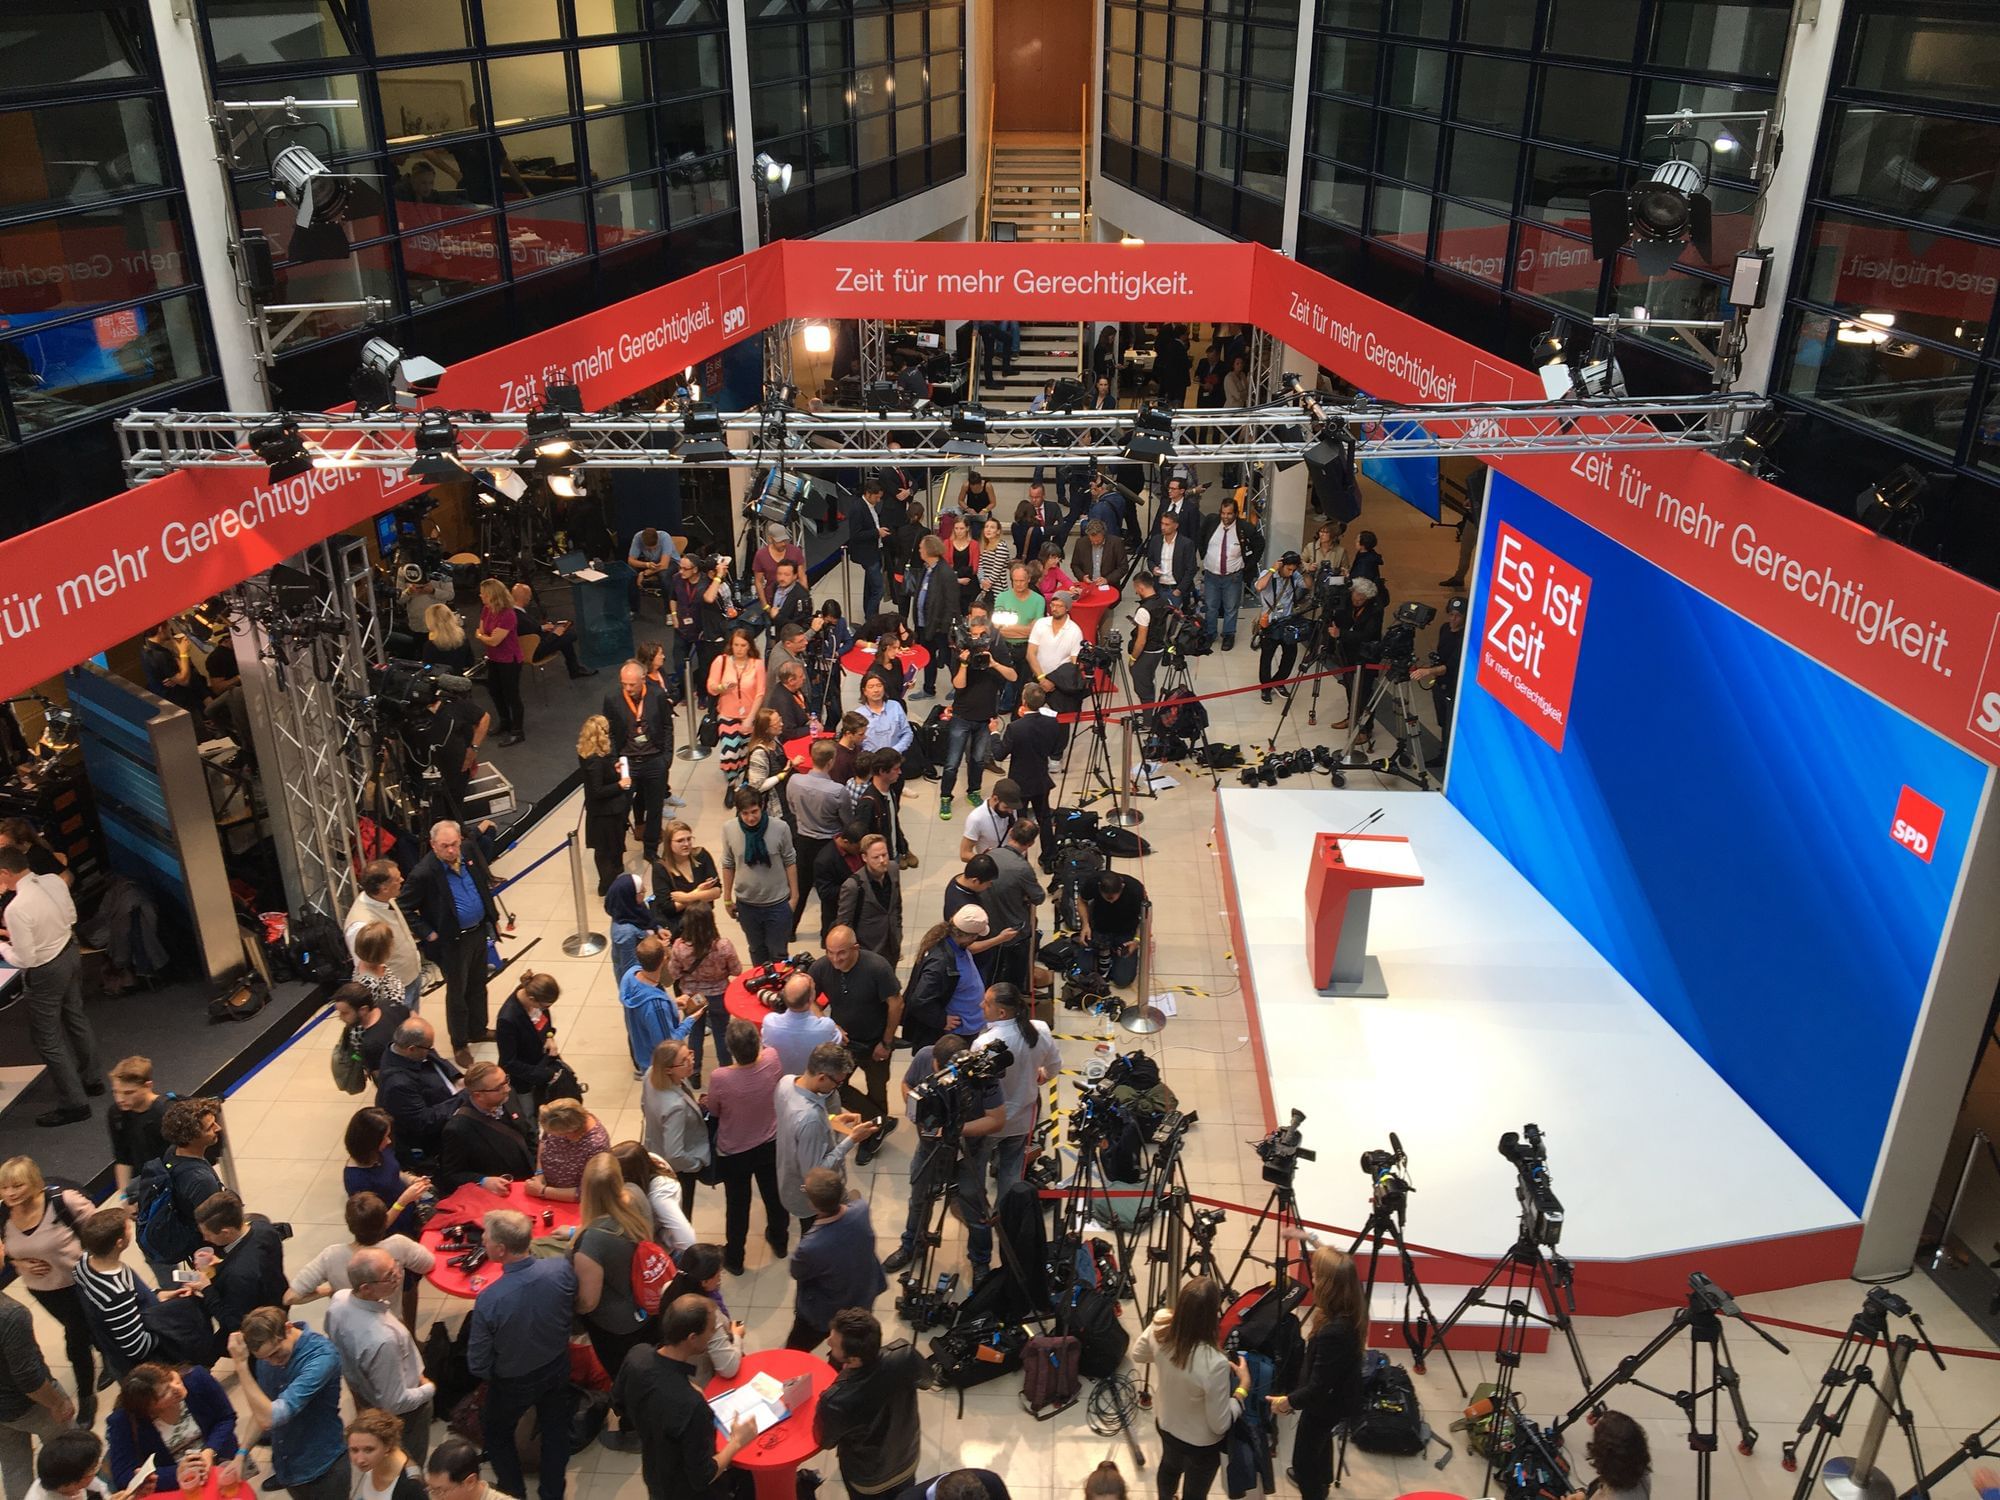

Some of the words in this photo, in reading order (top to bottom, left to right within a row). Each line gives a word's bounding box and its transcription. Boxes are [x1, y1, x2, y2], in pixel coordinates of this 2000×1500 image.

[723, 305, 746, 334] SPD
[835, 267, 884, 292] Zeit
[893, 268, 928, 293] für
[937, 269, 1004, 294] mehr
[1013, 268, 1194, 301] Gerechtigkeit.
[1289, 291, 1310, 326] Zeit
[1312, 303, 1329, 335] für
[1330, 319, 1362, 353] mehr
[500, 375, 539, 414] Zeit
[571, 345, 614, 385] mehr
[618, 302, 715, 363] Gerechtigkeit.
[0, 593, 43, 646] ür
[56, 544, 150, 616] mehr
[160, 466, 361, 565] Gerechtigkeit.
[1497, 534, 1535, 602] Es
[1542, 564, 1582, 637] ist
[1570, 452, 1613, 491] Zeit
[1619, 463, 1652, 509] für
[1655, 491, 1725, 548] mehr
[1731, 523, 1953, 678] Gerechtigkeit.
[1487, 594, 1545, 679] Zeit
[1484, 651, 1496, 667] für
[1494, 662, 1513, 683] mehr
[1513, 675, 1564, 725] Gerechtigkeit.
[1892, 819, 1929, 854] SPD
